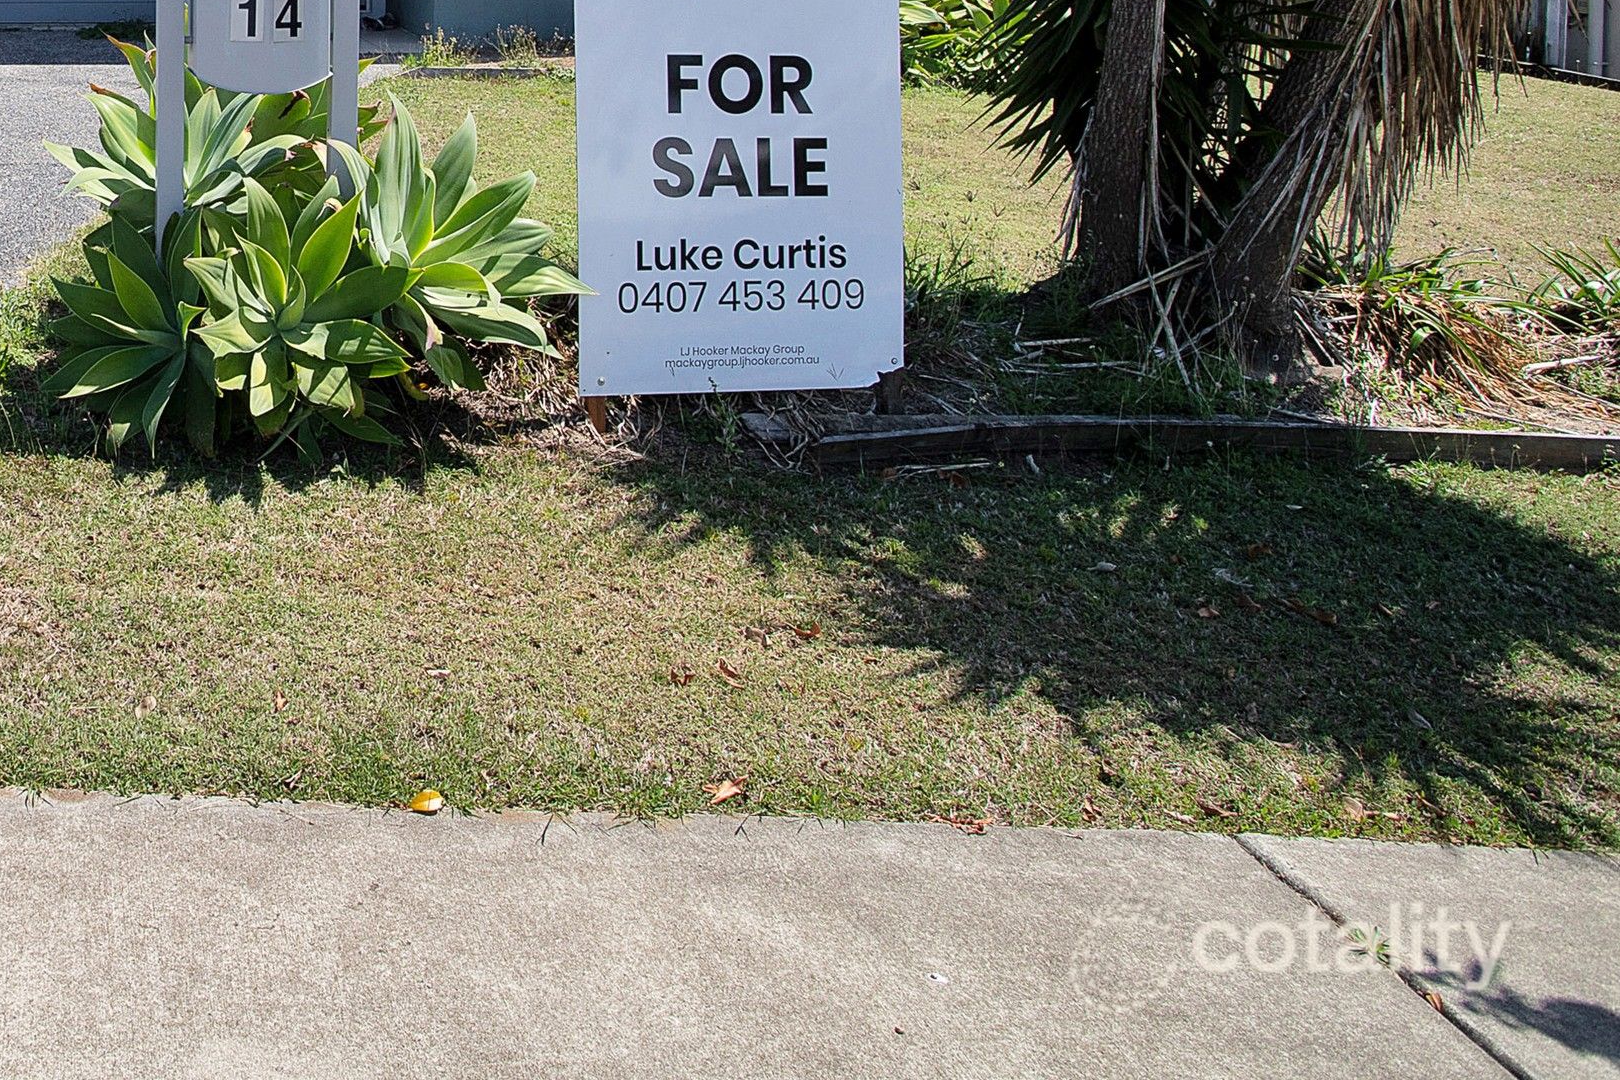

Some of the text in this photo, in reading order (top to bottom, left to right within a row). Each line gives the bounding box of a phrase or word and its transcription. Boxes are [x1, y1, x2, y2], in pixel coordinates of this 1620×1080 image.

[666, 53, 814, 114] FOR
[652, 136, 829, 198] SALE
[636, 235, 847, 271] Luke Curtis
[617, 278, 865, 313] 0407 453 409
[665, 355, 820, 369] mackaygroup.ljhooker.com.au
[680, 344, 805, 358] LJ Hooker Mackay Group
